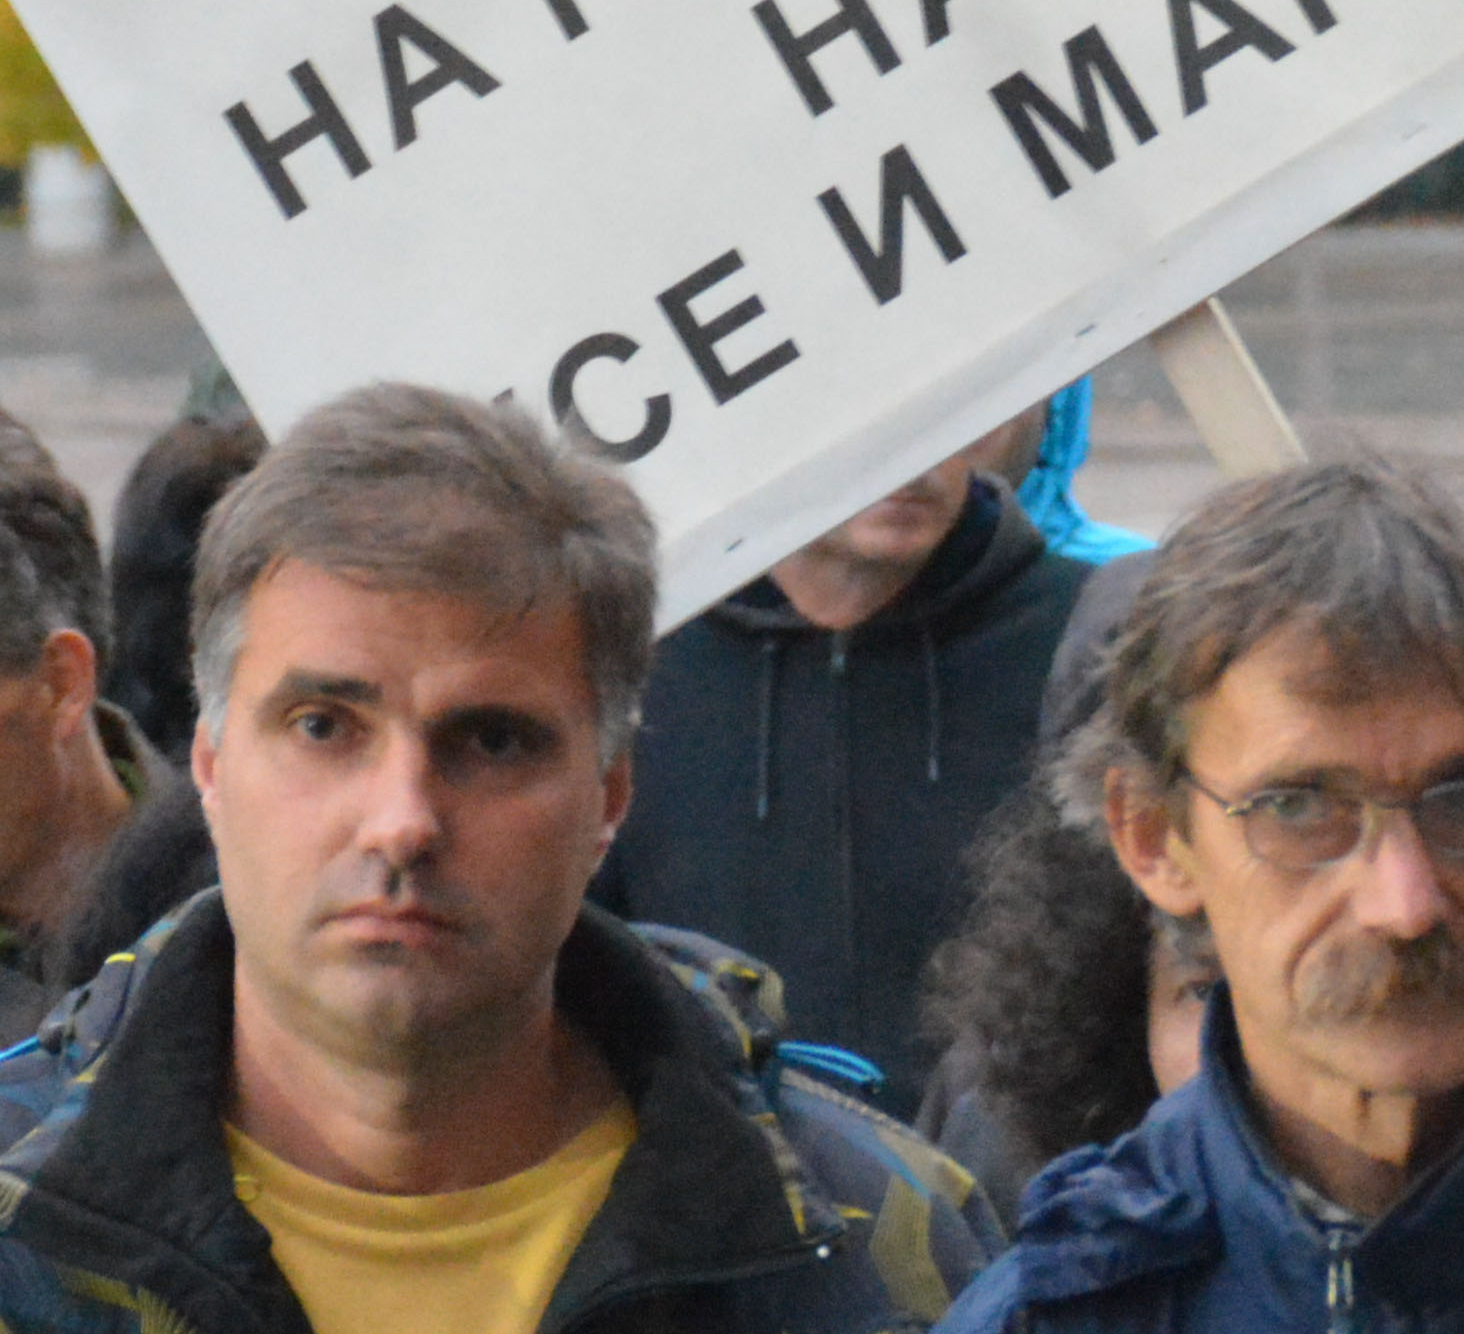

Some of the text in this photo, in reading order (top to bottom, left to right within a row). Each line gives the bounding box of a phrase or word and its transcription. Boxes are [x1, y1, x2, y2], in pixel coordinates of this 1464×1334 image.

[223, 4, 501, 222] НА
[493, 247, 801, 465] СЕ
[818, 144, 967, 305] И
